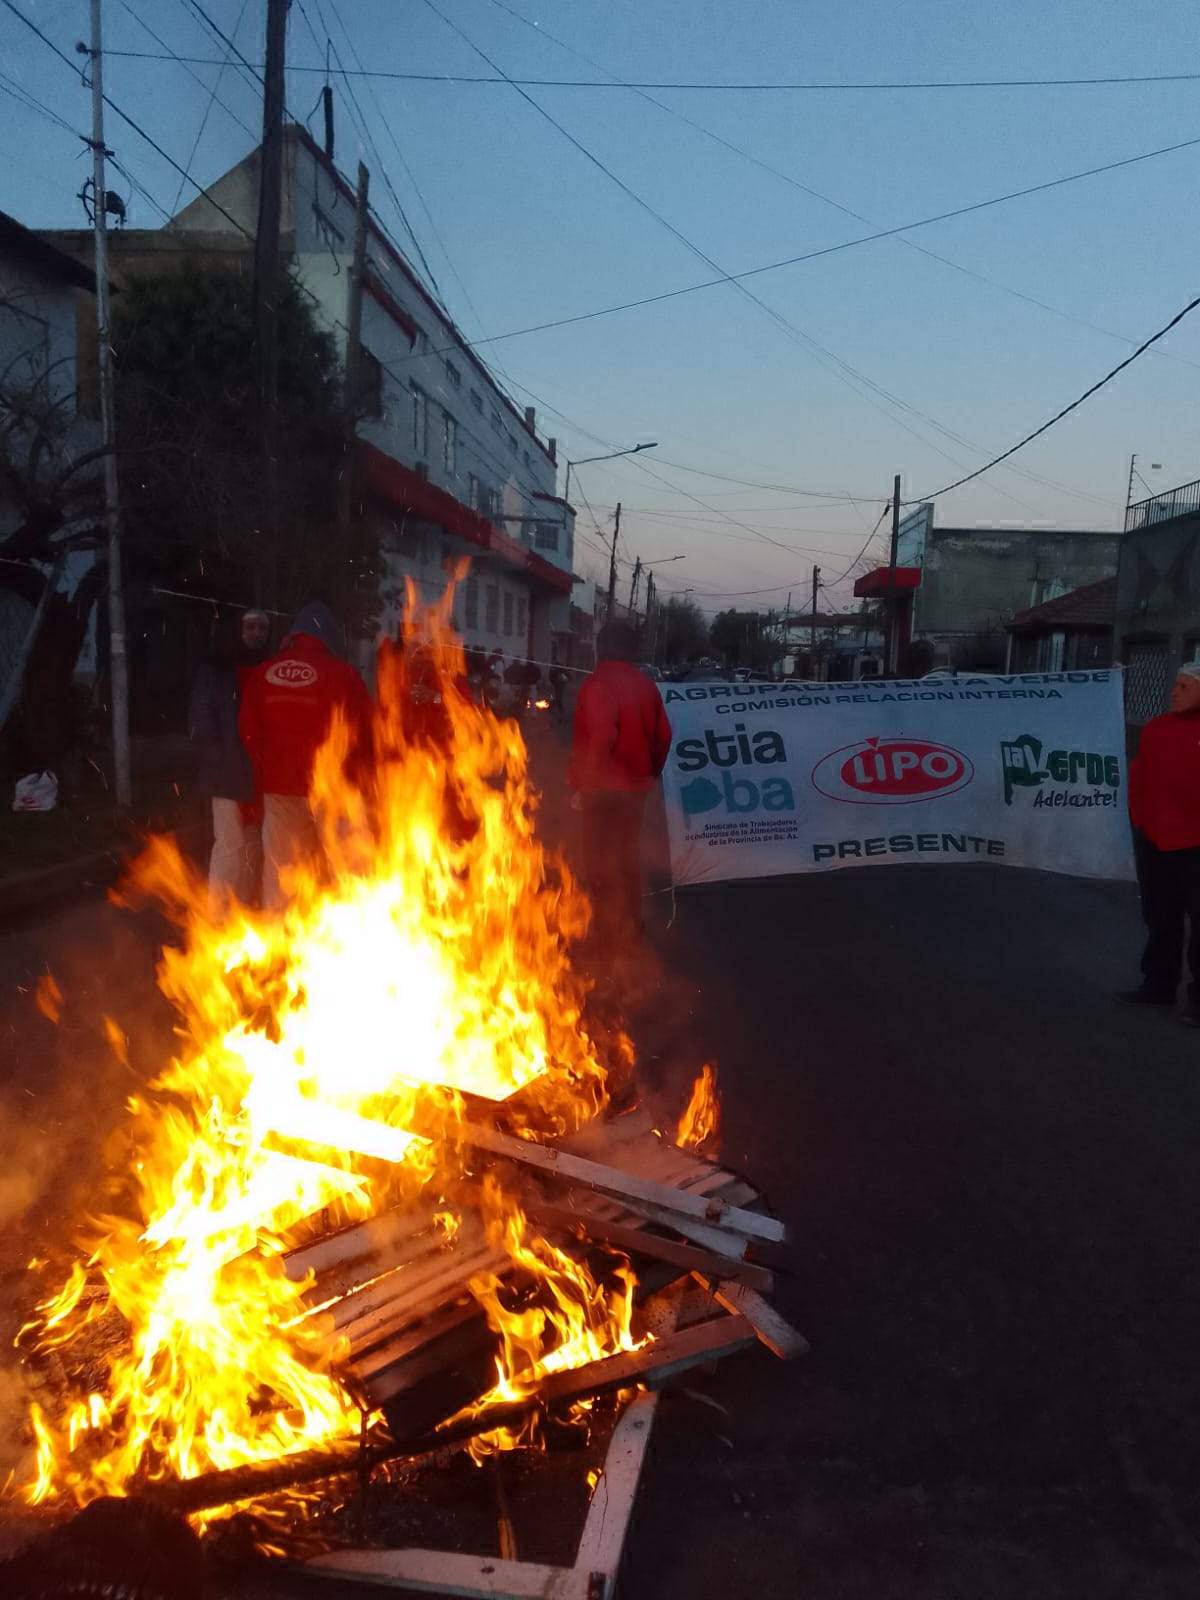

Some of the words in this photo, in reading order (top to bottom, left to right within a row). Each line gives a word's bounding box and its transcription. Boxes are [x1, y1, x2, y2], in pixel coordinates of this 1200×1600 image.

[278, 667, 312, 679] LIPO
[959, 689, 1063, 700] INTERNA
[675, 723, 787, 772] stia
[852, 749, 959, 785] LIPO
[1033, 789, 1117, 808] Adelante!
[813, 833, 1005, 862] PRESENTE
